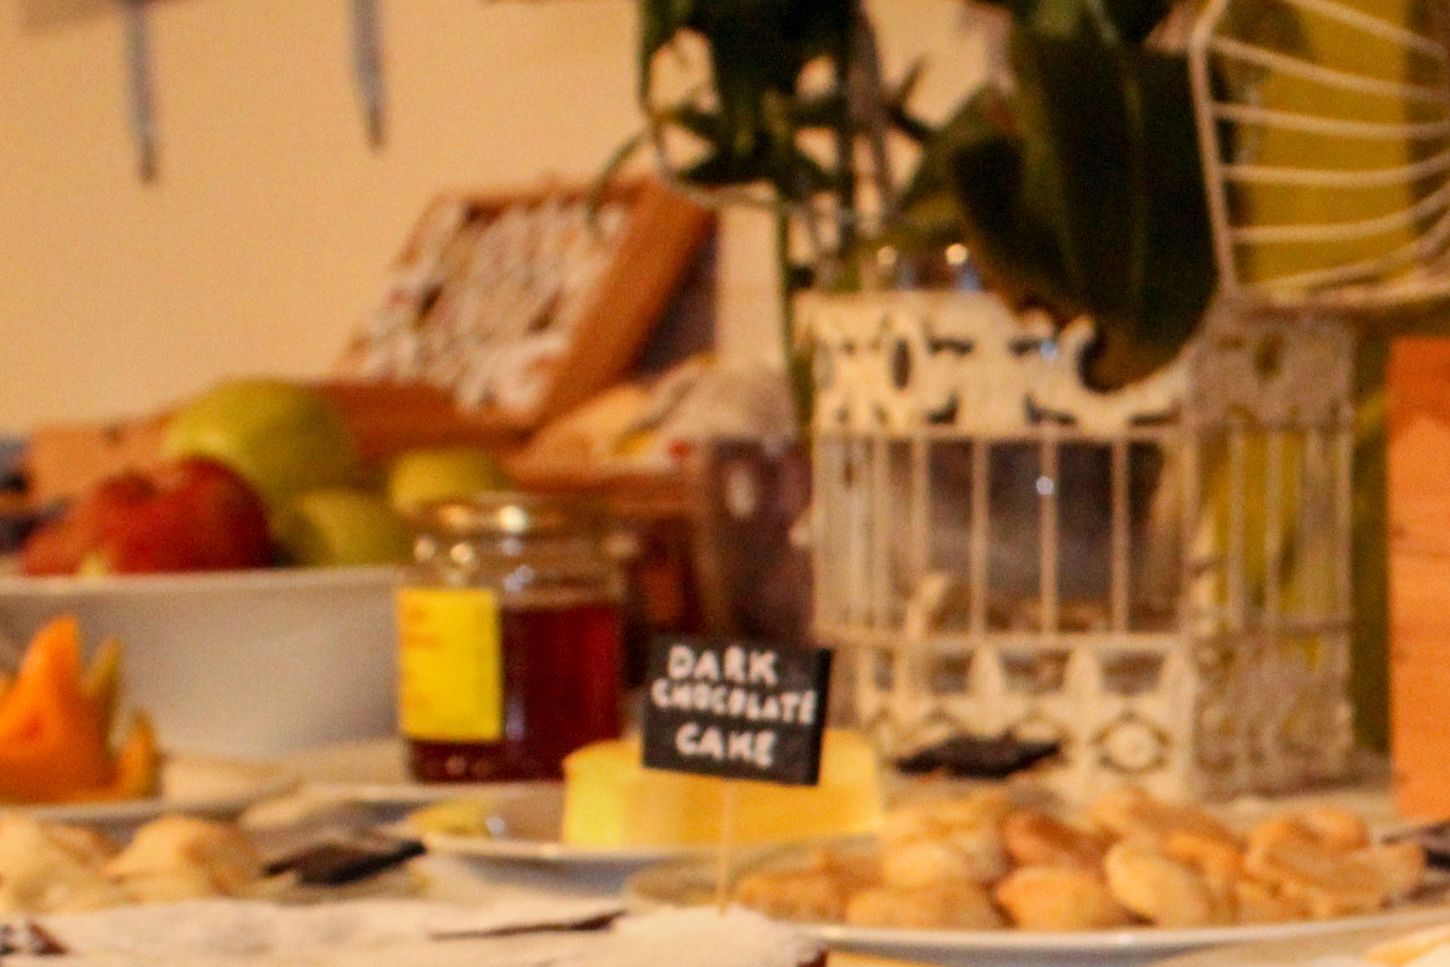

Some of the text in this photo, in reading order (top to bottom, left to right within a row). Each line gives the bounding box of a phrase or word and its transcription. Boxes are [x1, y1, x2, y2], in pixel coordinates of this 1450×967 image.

[668, 644, 778, 687] DARK
[651, 678, 817, 726] CHOCOLATE
[675, 722, 776, 769] CAKE
